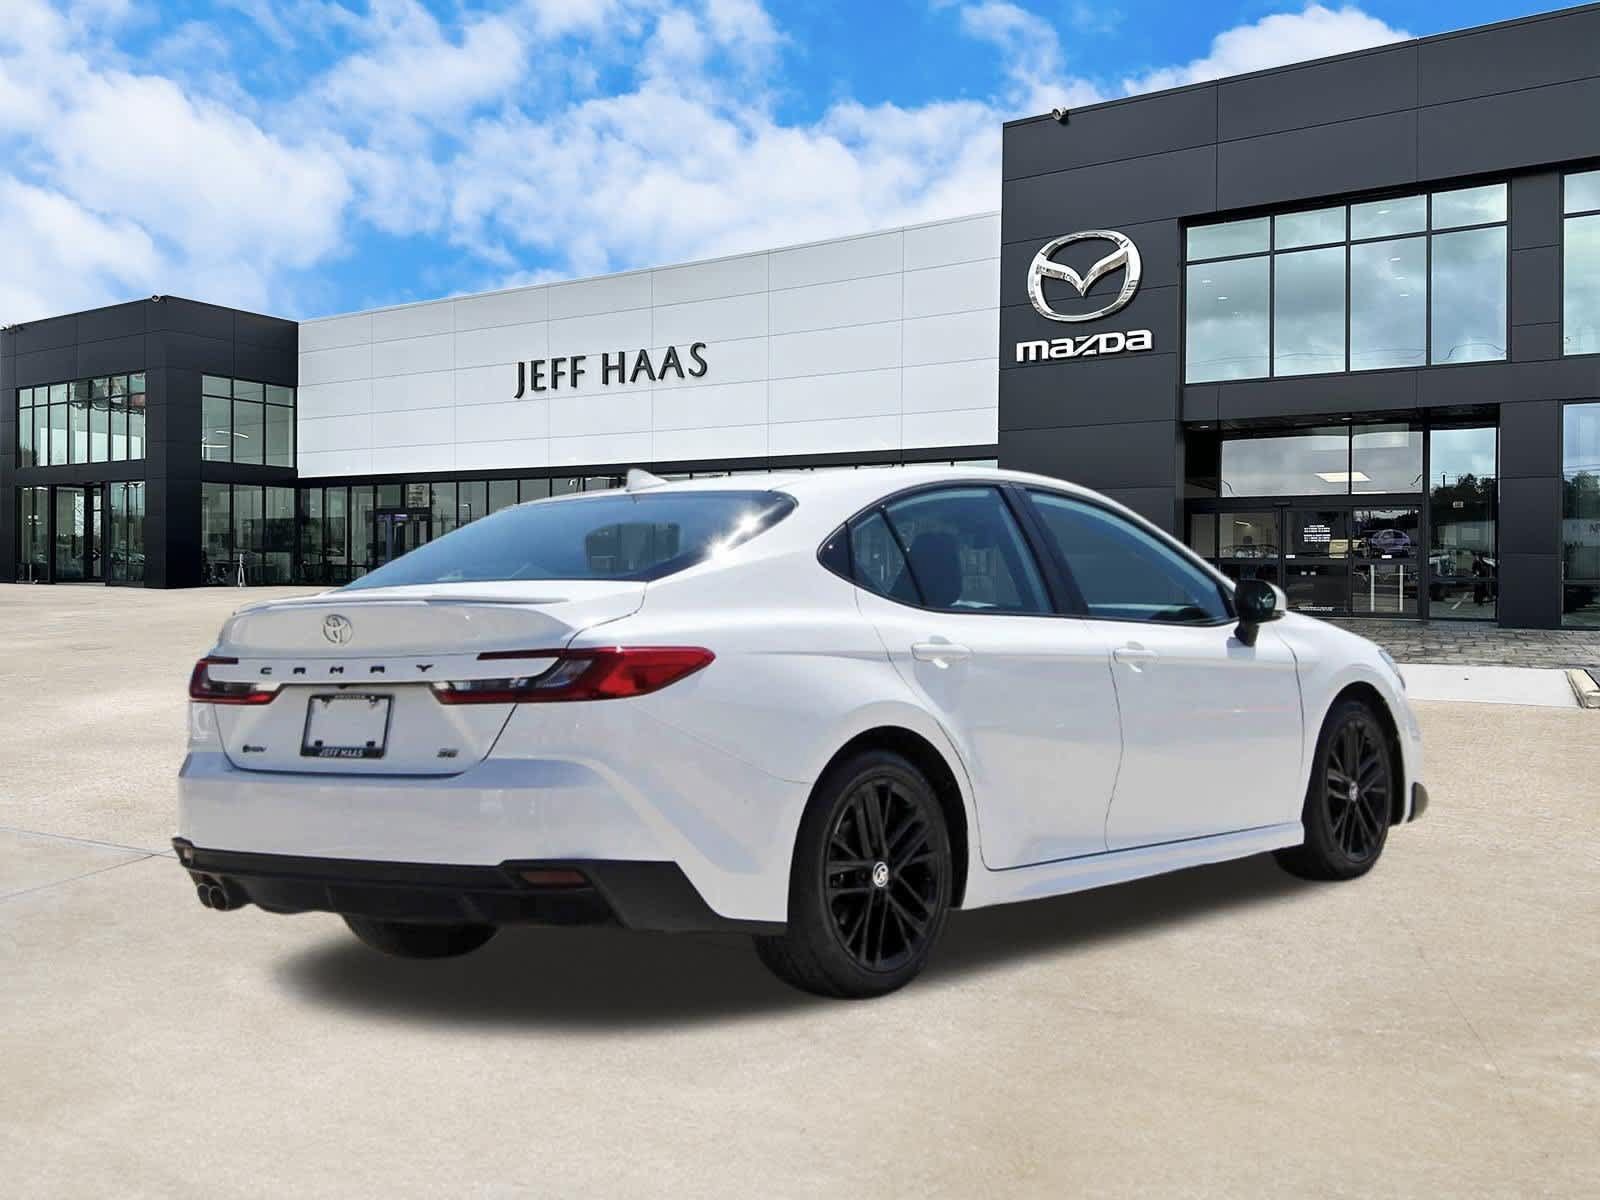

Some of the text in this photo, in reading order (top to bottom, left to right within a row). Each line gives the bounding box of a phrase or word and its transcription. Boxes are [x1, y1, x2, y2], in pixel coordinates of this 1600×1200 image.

[513, 342, 709, 399] JEFF HAAS
[259, 663, 434, 676] CAMRY
[319, 747, 338, 758] JEFF
